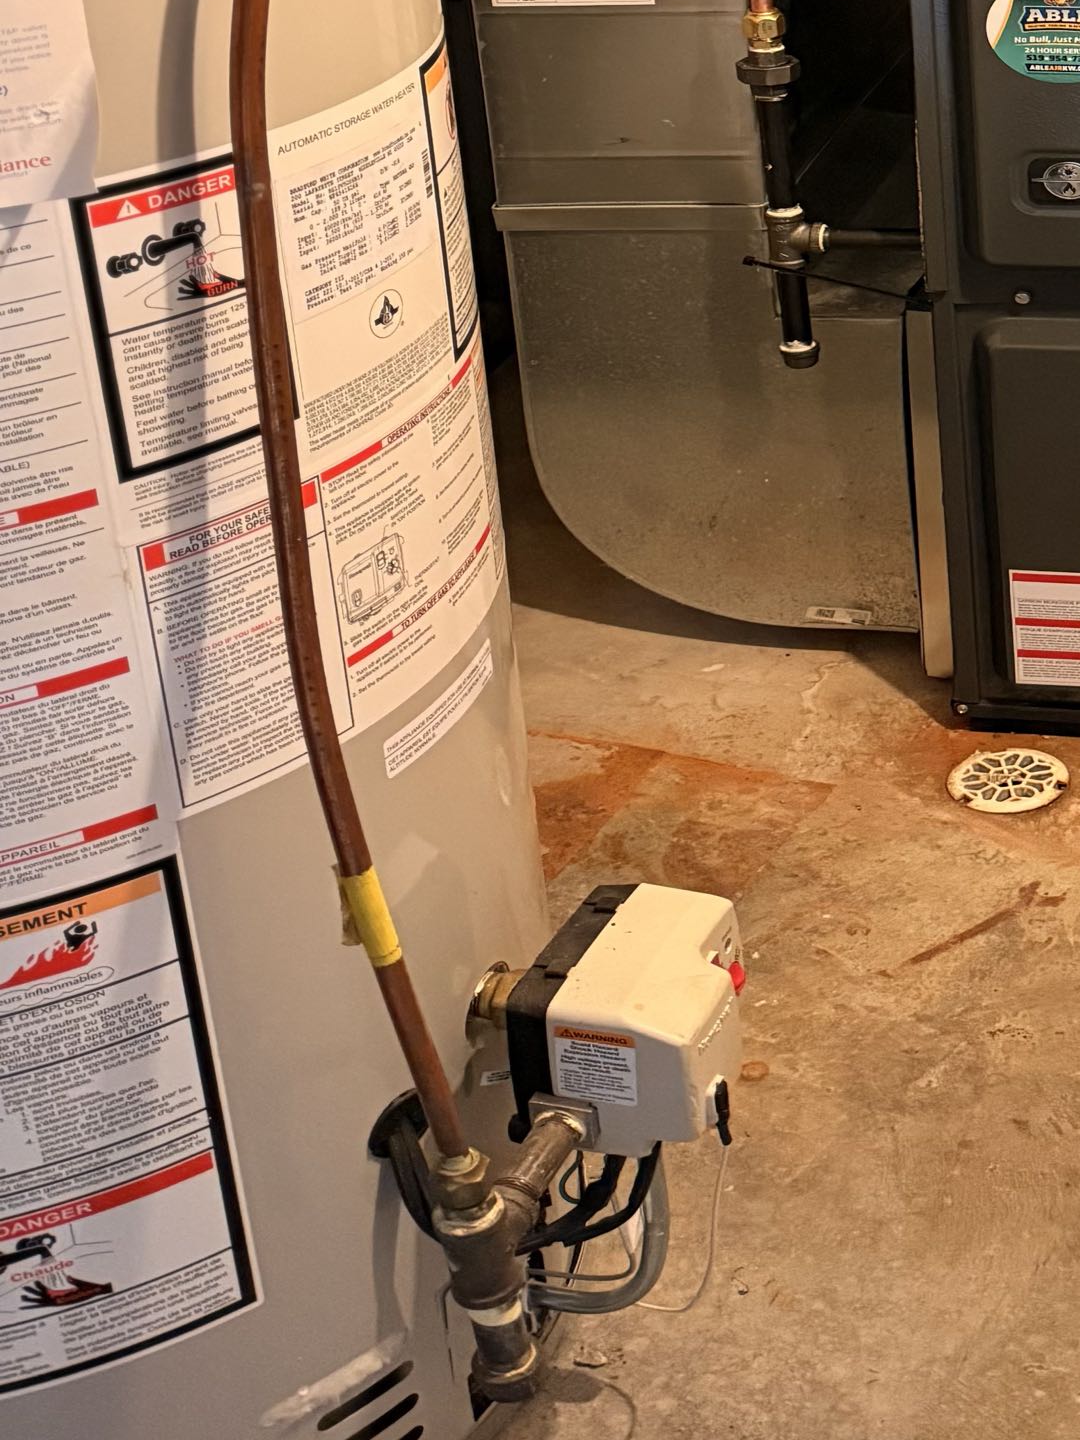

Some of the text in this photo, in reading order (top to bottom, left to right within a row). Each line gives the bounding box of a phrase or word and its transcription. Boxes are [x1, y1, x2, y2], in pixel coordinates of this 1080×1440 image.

[278, 128, 332, 156] AUTOMATIC
[334, 109, 371, 133] STORAGE
[372, 95, 395, 116] WATER
[148, 174, 231, 209] DANGER
[186, 251, 216, 269] HOT
[207, 280, 238, 297] BURN
[122, 334, 150, 346] Water
[209, 309, 228, 320] over
[169, 527, 243, 559] READ BEFORE
[189, 527, 211, 544] FOR
[214, 518, 243, 534] YOUR
[573, 1032, 627, 1044] WARNING
[10, 1260, 74, 1283] Chaude
